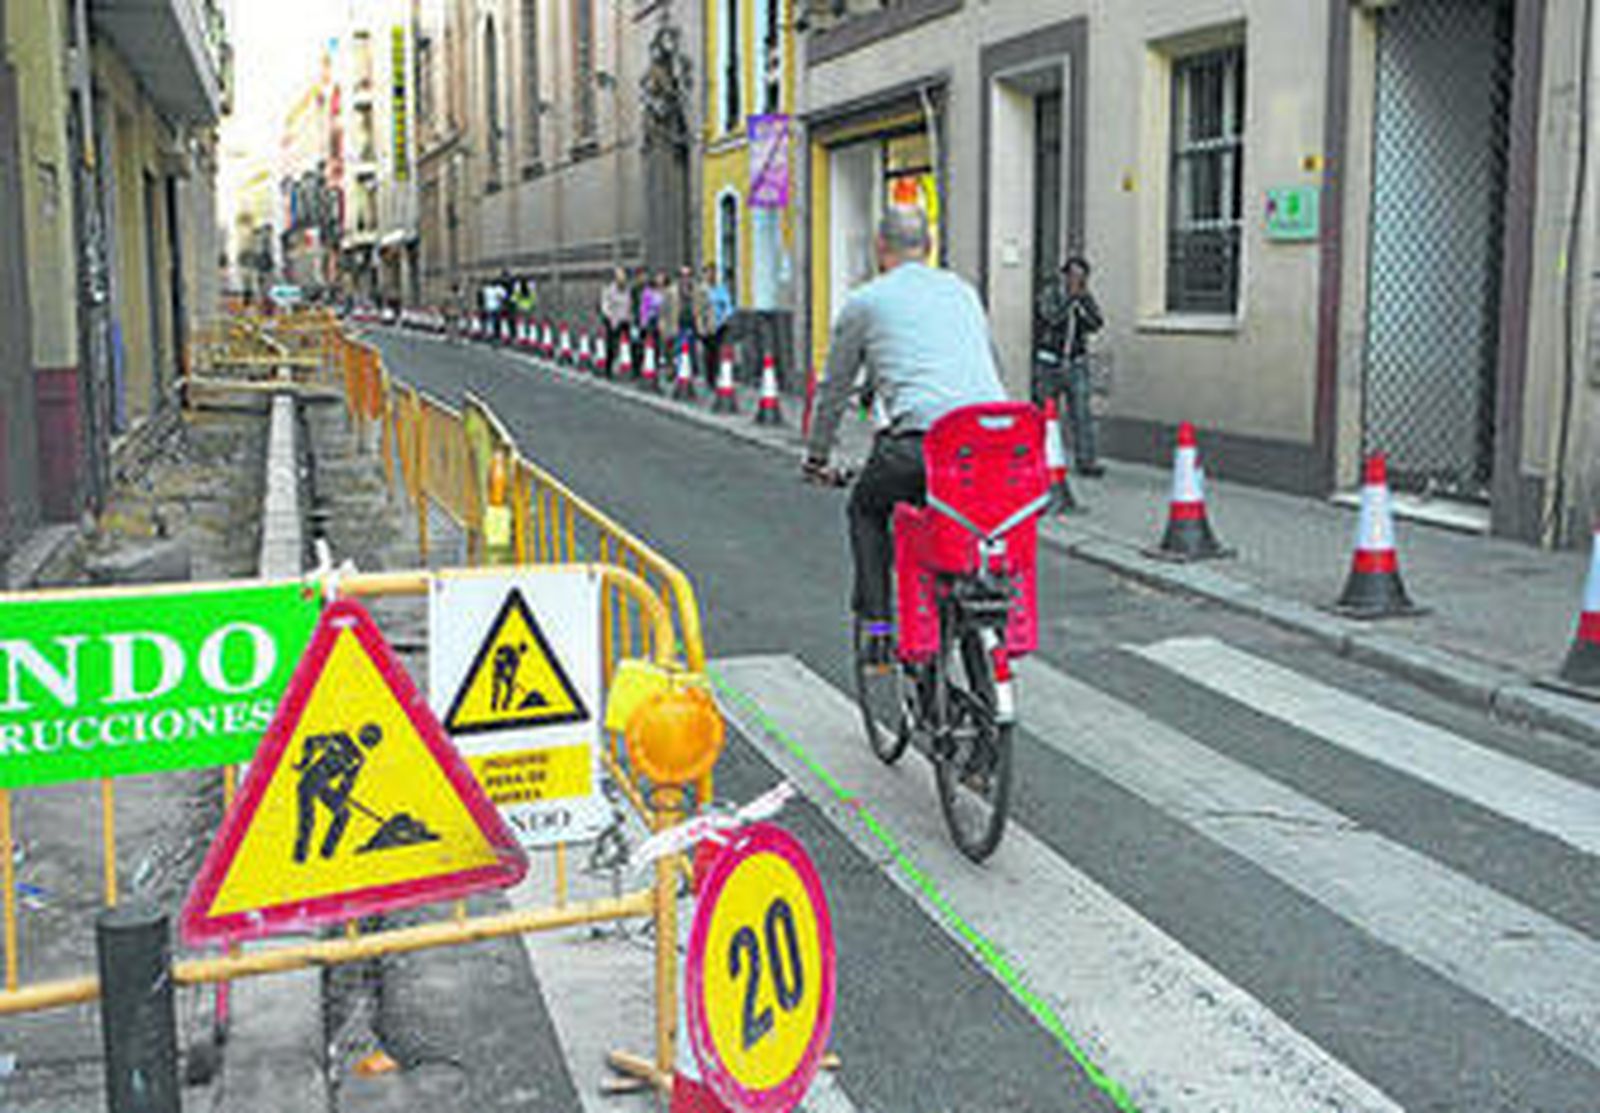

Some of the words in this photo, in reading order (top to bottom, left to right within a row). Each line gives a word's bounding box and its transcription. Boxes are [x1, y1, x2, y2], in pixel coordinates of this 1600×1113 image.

[0, 622, 278, 711] NDO
[0, 699, 274, 753] RUCCIONES
[728, 897, 804, 1051] 20
